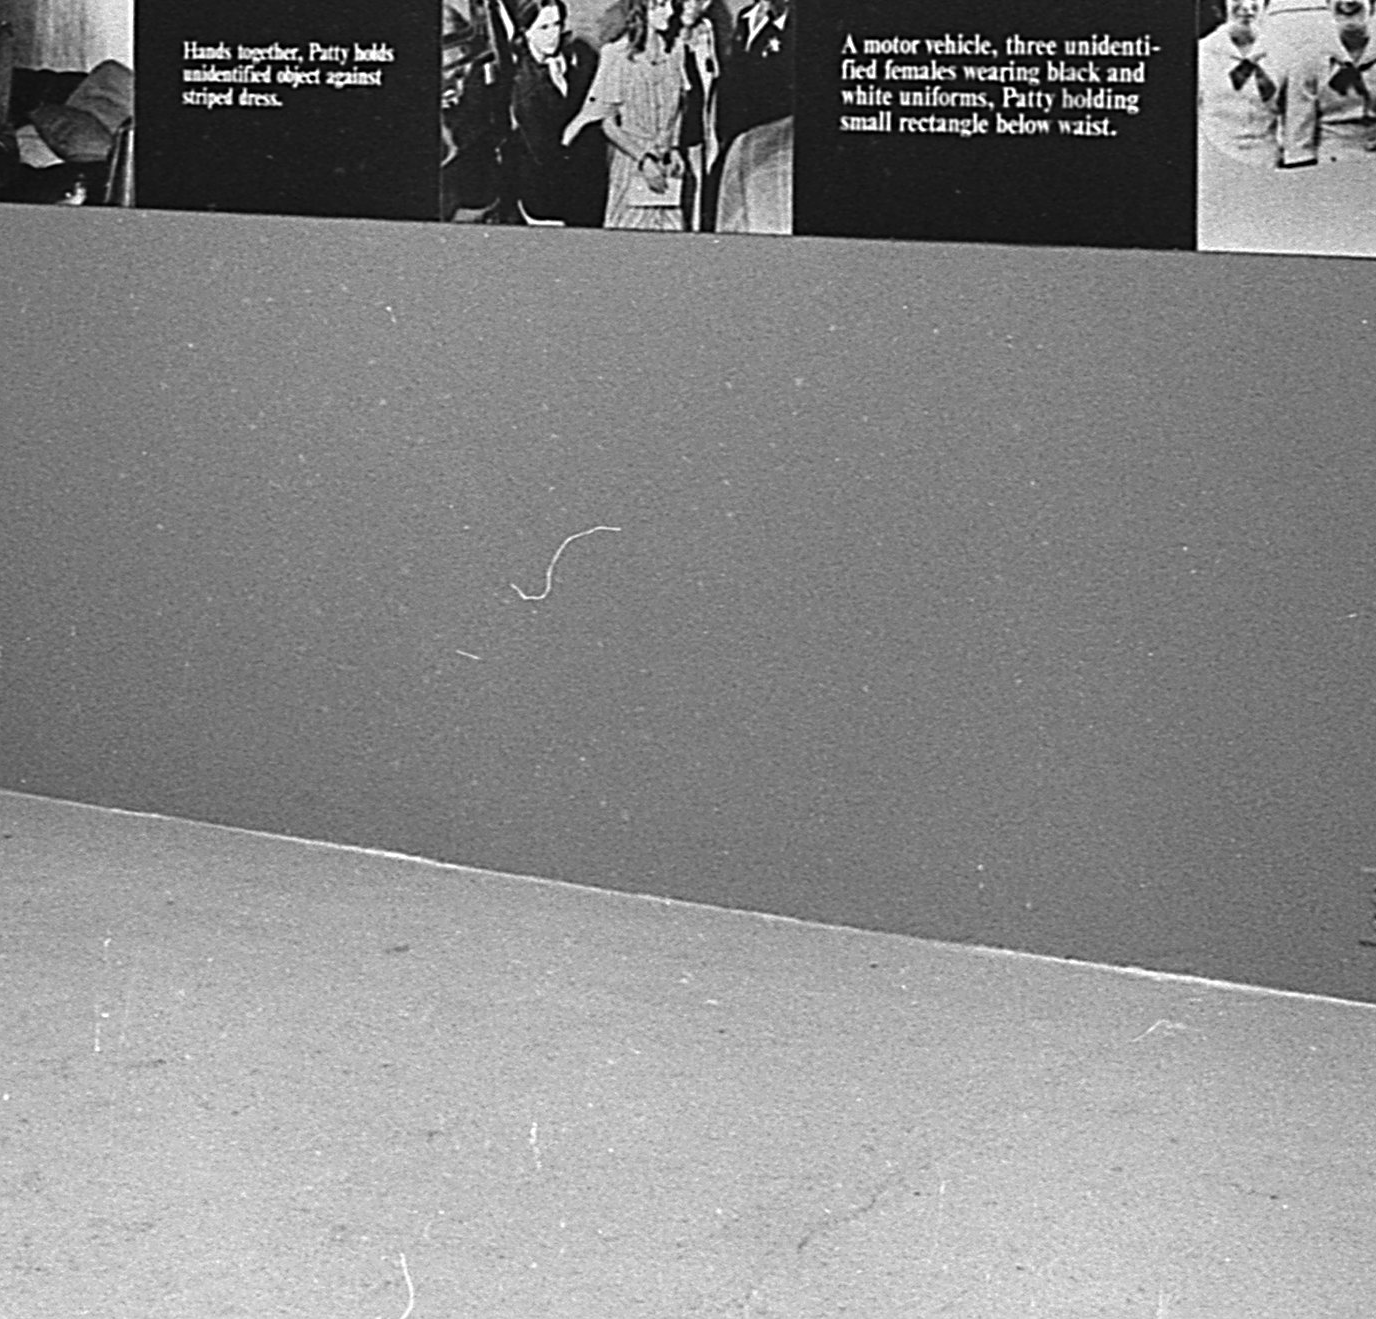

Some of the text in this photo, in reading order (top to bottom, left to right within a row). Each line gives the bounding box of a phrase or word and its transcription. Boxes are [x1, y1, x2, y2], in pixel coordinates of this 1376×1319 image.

[183, 40, 395, 67] Hands together, Patty holds
[841, 32, 1162, 59] A motor vehicle, three unidenti-
[182, 63, 383, 89] unidentified object against
[841, 58, 1146, 86] fied females wearing black and
[181, 86, 284, 110] striped dress.
[840, 84, 1140, 116] white uniforms, Patty holding
[839, 110, 1118, 137] small rectangle below waist.
